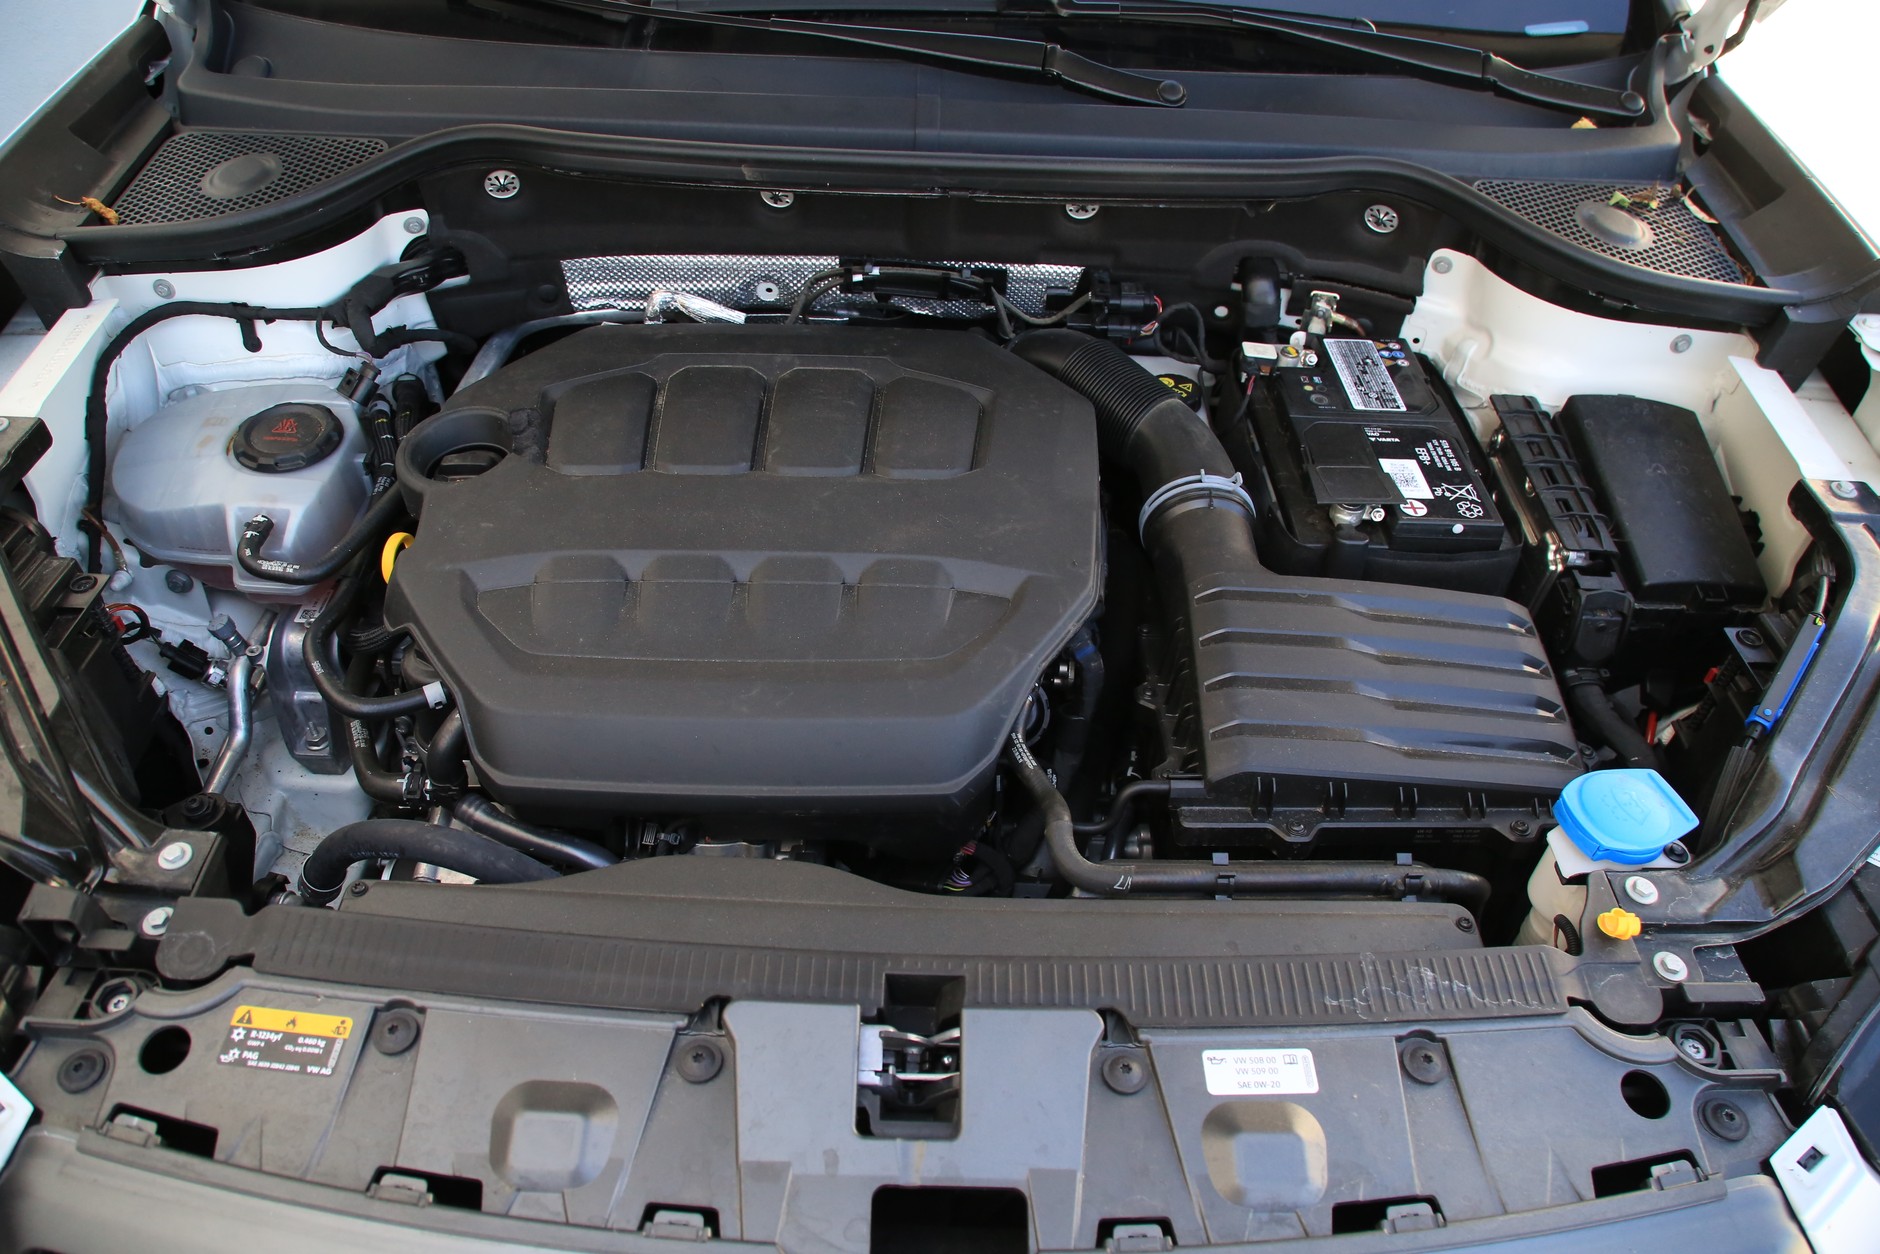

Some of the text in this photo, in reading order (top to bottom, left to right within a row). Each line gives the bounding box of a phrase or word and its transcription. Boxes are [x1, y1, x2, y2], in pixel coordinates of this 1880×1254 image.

[1414, 447, 1431, 466] EFB+
[1432, 487, 1442, 496] Pb
[250, 1031, 283, 1042] R-1234yf
[318, 1038, 326, 1047] kg
[242, 1051, 259, 1060] PAG
[307, 1065, 319, 1074] VW
[320, 1066, 332, 1075] AG
